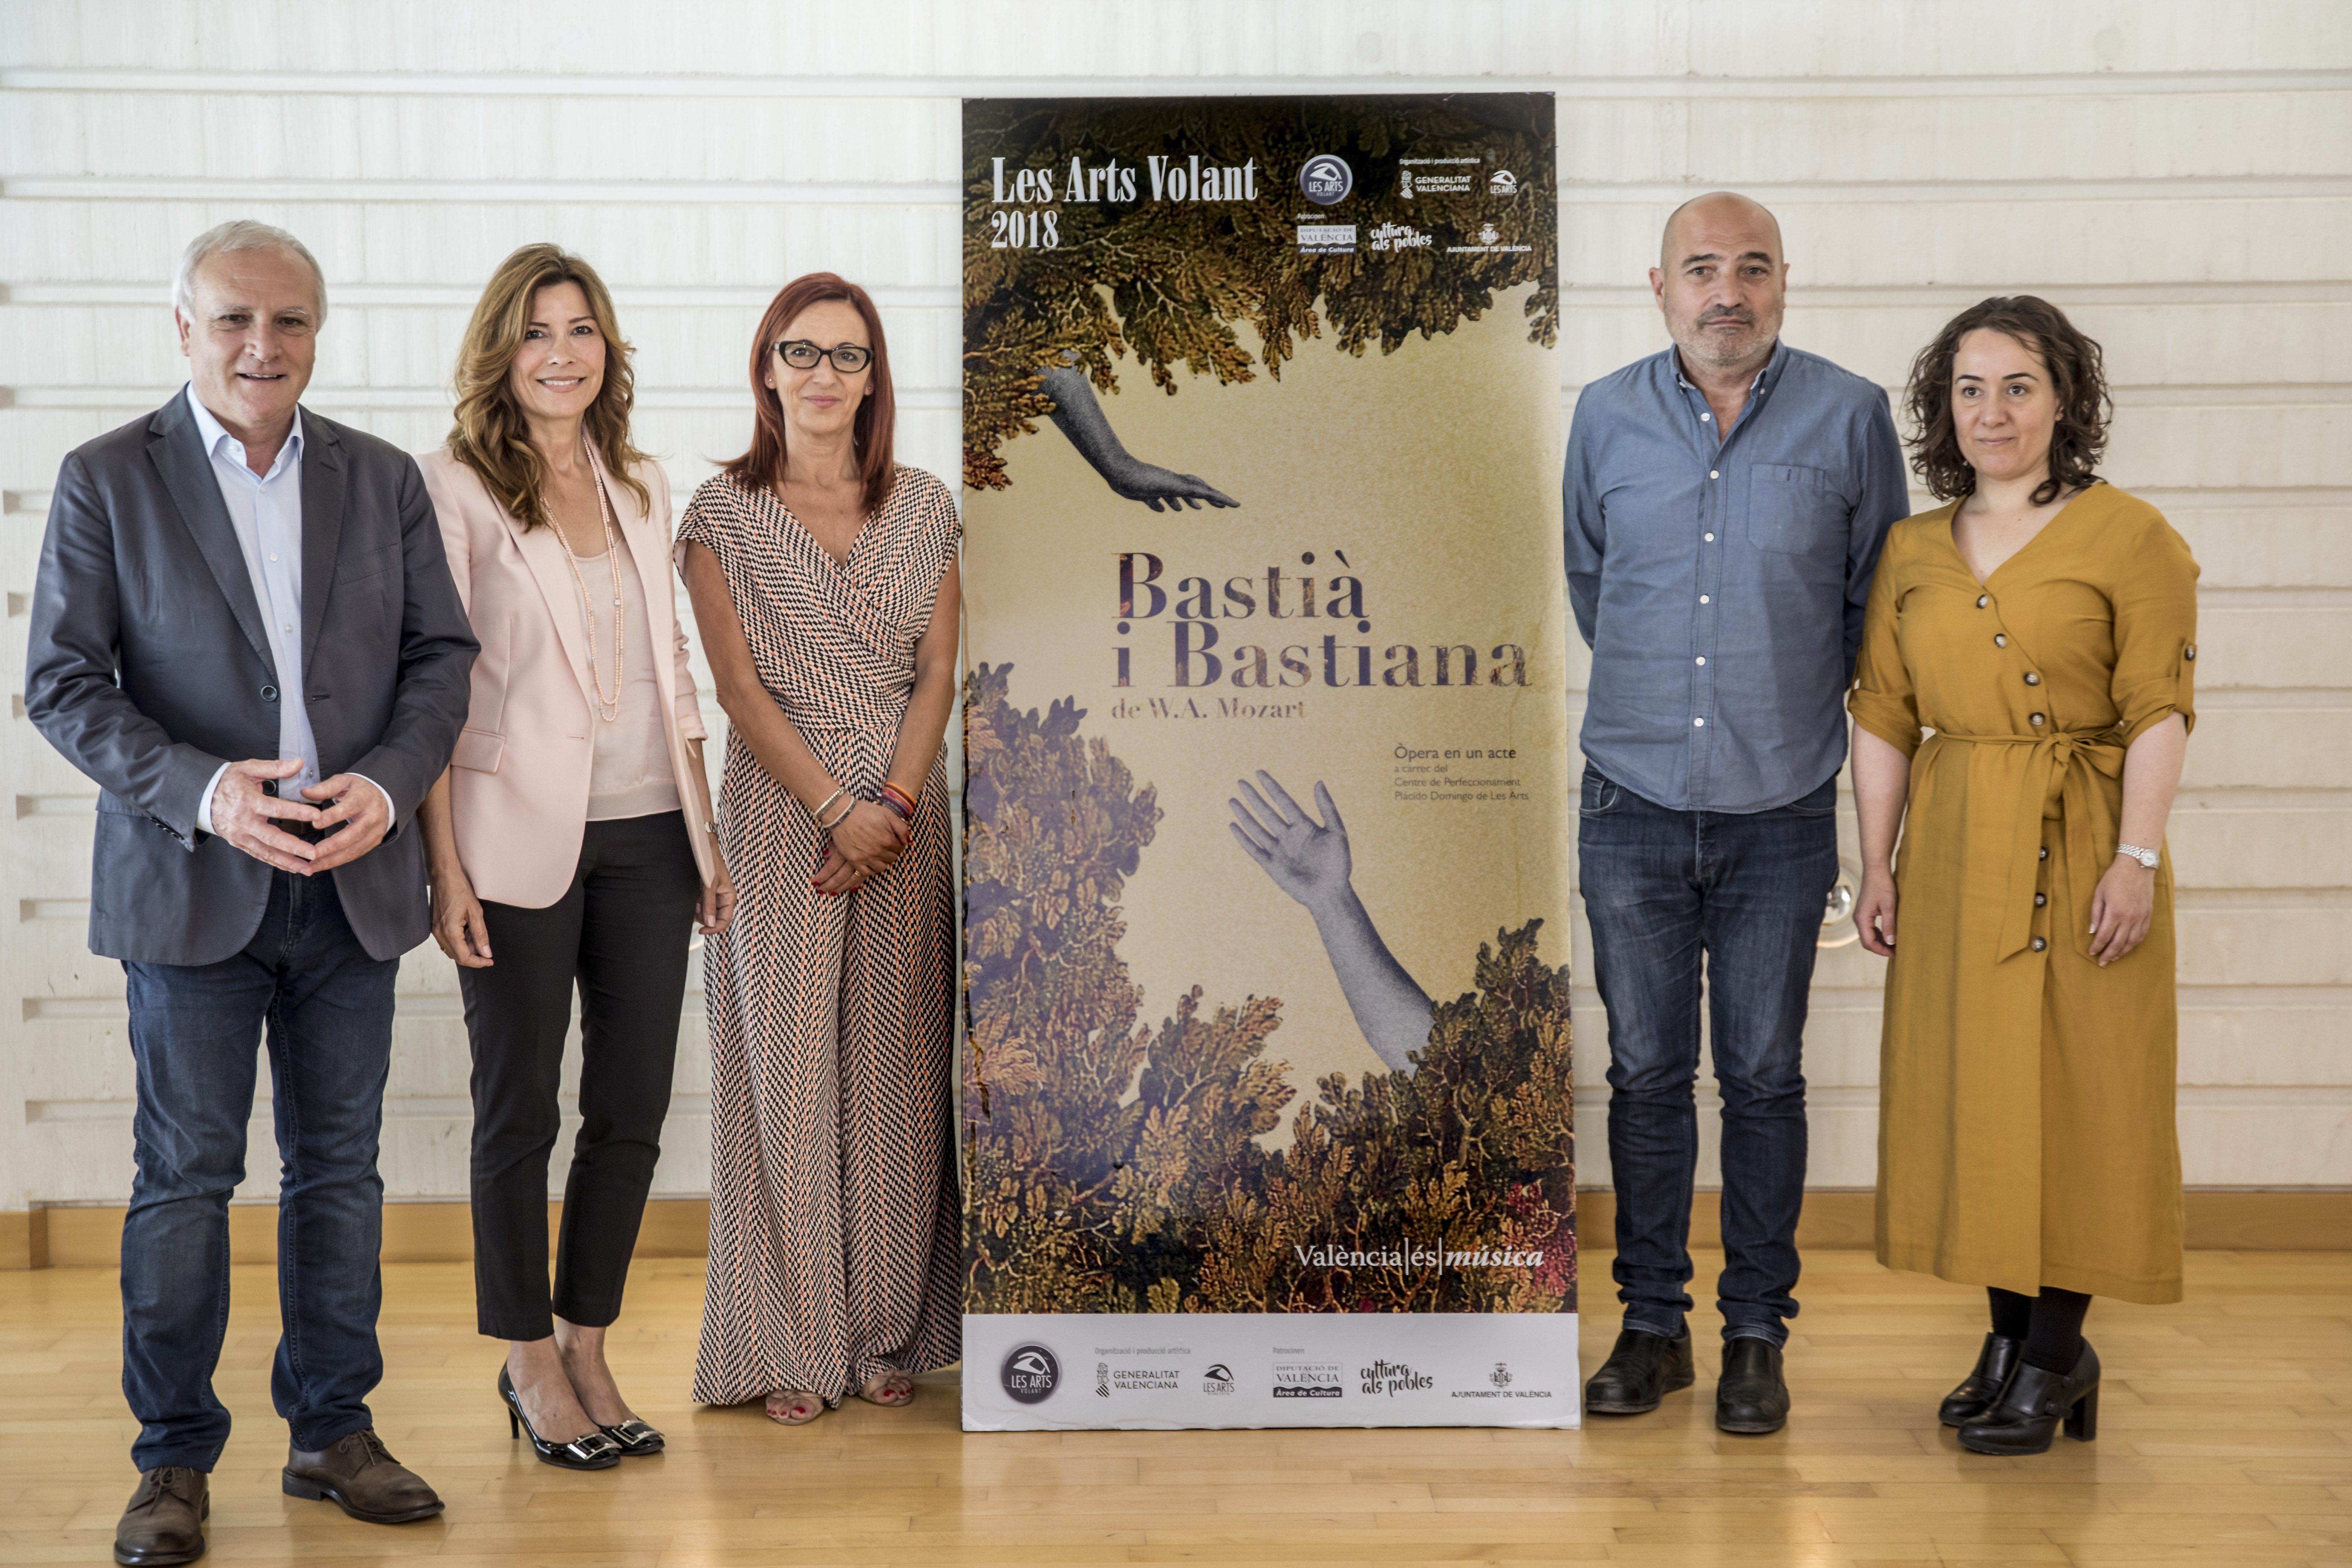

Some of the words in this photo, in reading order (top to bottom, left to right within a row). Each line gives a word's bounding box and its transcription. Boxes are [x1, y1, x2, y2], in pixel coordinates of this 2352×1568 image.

[991, 157, 1053, 203] Les
[1064, 156, 1137, 202] Arts
[1148, 155, 1258, 201] Volant
[1309, 181, 1323, 192] LES
[1324, 181, 1343, 192] ARTS
[1490, 185, 1501, 193] LES
[1501, 185, 1517, 193] ARTS
[991, 210, 1059, 248] 2018
[1370, 221, 1415, 238] cultura
[1372, 230, 1390, 250] als
[1394, 231, 1432, 253] pobles
[1111, 549, 1370, 619] Bastià
[1111, 622, 1136, 687] i
[1167, 620, 1533, 687] Bastiana
[1111, 698, 1140, 719] de
[1148, 698, 1207, 719] W.A.
[1216, 698, 1307, 719] Mozart
[1394, 743, 1439, 762] Òpera
[1444, 750, 1460, 758] en
[1466, 750, 1483, 758] un
[1488, 749, 1517, 758] acte
[1395, 778, 1427, 786] Centre
[1444, 778, 1521, 786] Perfeccionament
[1431, 791, 1473, 802] Domingo
[1476, 791, 1487, 800] de
[1491, 791, 1506, 800] Les
[1509, 791, 1529, 800] Arts
[1276, 1372, 1339, 1382] VALÈNCIA
[1361, 1359, 1412, 1379] cultura
[1012, 1375, 1027, 1388] LES
[1030, 1375, 1052, 1388] ARTS
[1203, 1383, 1215, 1392] LES
[1217, 1383, 1235, 1392] ARTS
[1362, 1370, 1383, 1394] als
[1389, 1371, 1433, 1398] pobles
